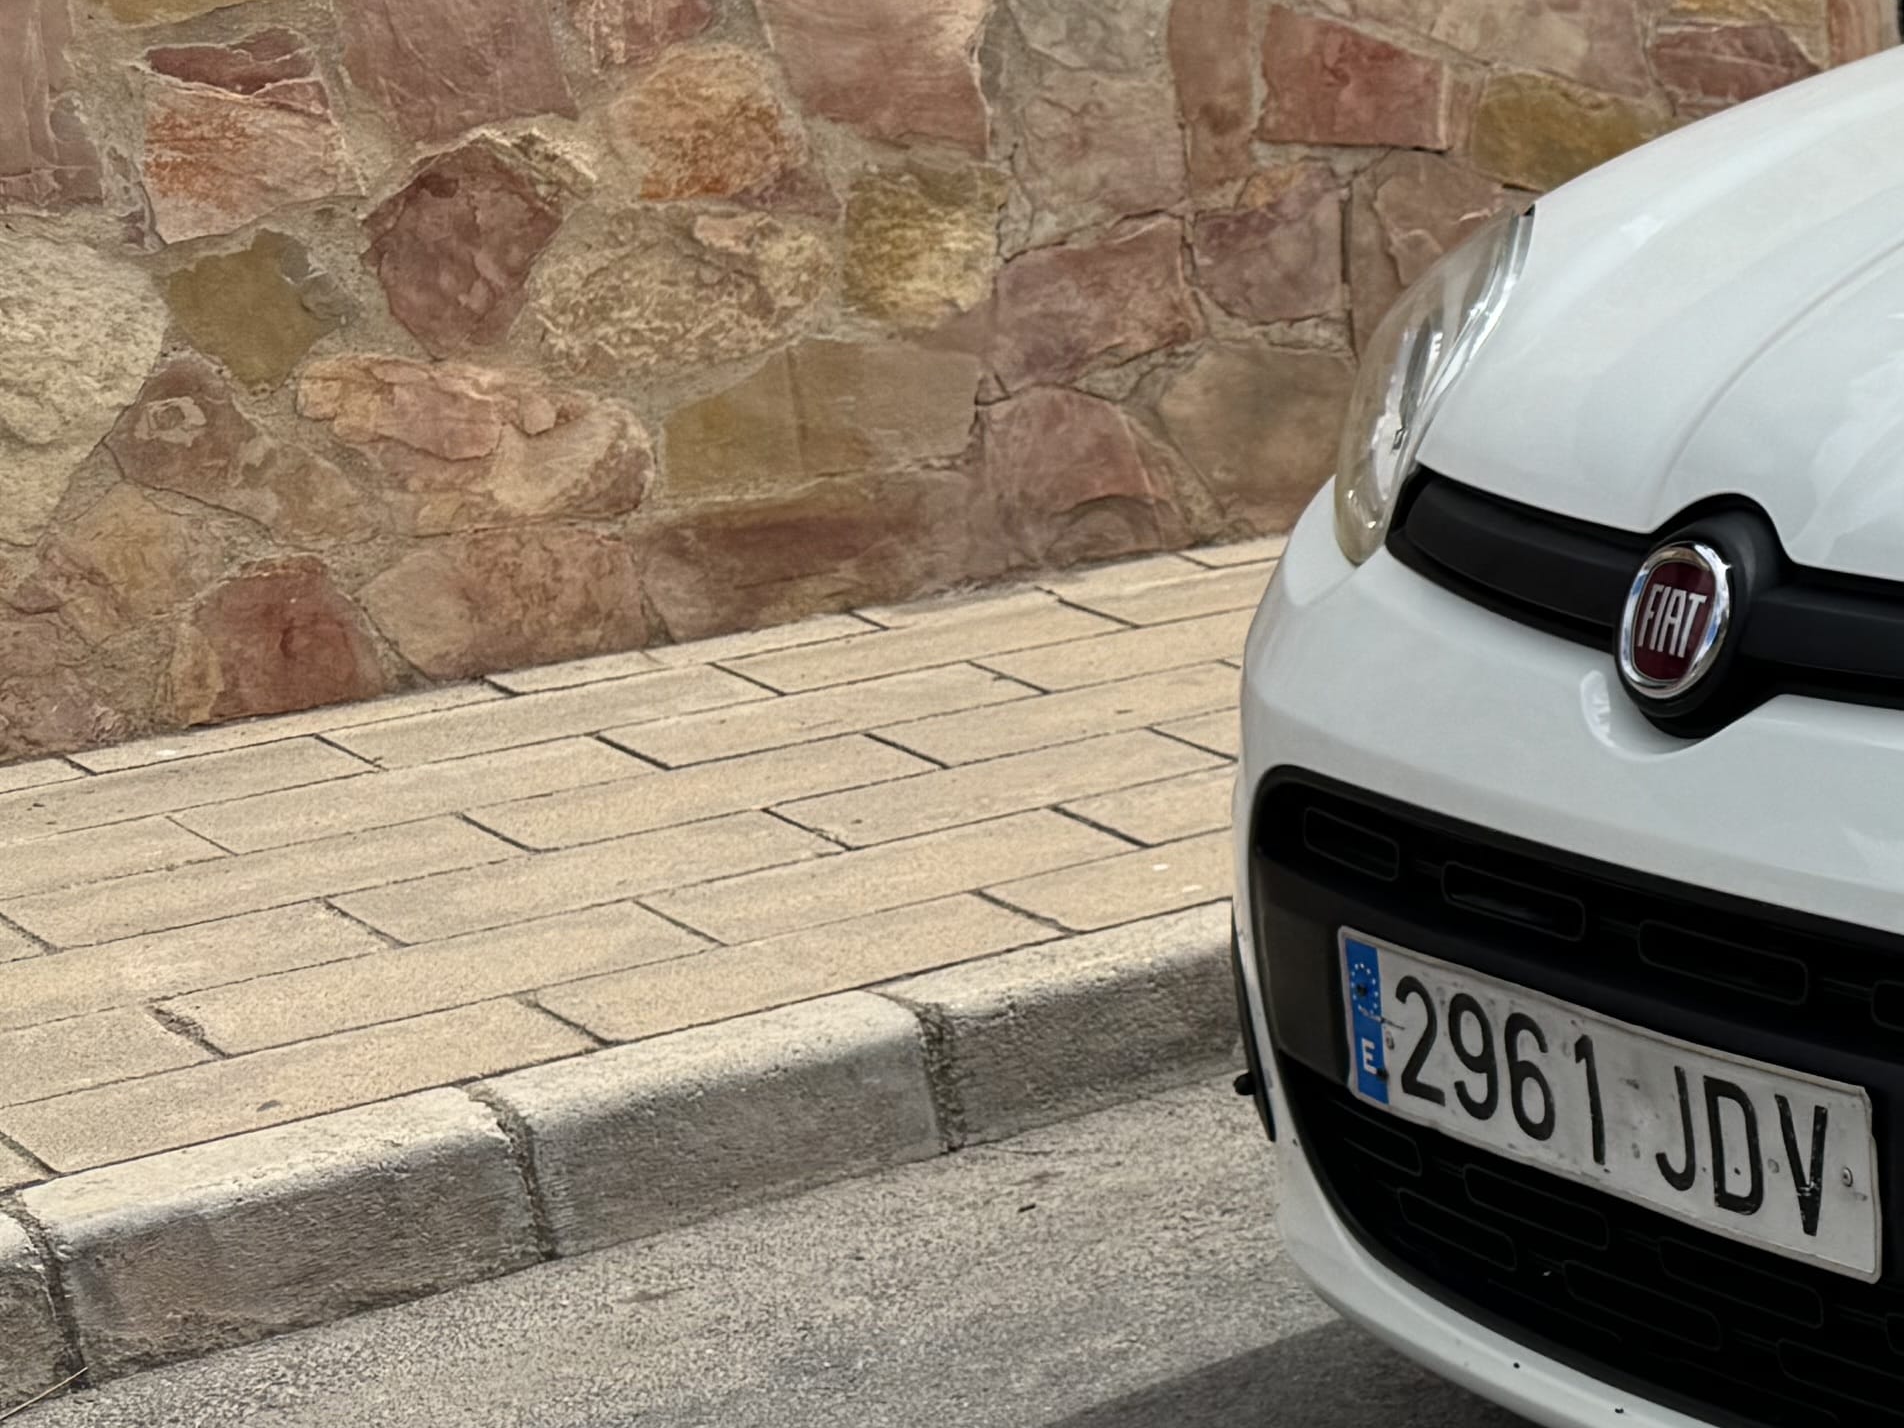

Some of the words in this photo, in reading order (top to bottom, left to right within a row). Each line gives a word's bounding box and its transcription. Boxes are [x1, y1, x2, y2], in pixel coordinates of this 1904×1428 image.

[1638, 583, 1708, 659] FIAT
[1361, 1037, 1378, 1075] E
[1395, 975, 1606, 1166] 2961
[1656, 1065, 1828, 1237] JDV
